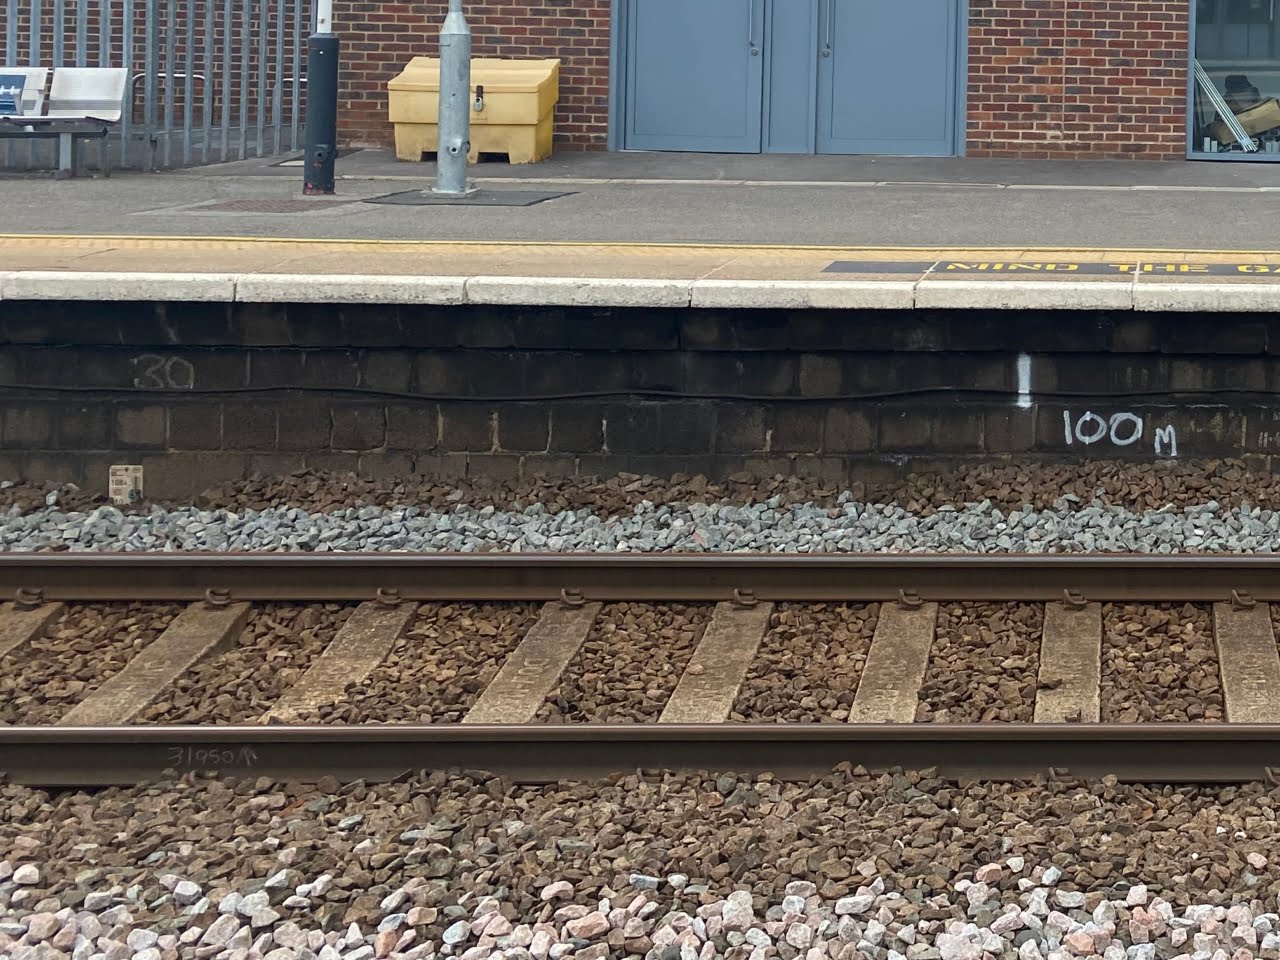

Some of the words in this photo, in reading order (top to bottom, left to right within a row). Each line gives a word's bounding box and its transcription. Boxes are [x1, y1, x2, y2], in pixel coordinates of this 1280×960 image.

[946, 262, 1078, 271] MIND
[1108, 263, 1209, 273] THE
[1063, 410, 1143, 446] 100
[1154, 424, 1177, 456] M
